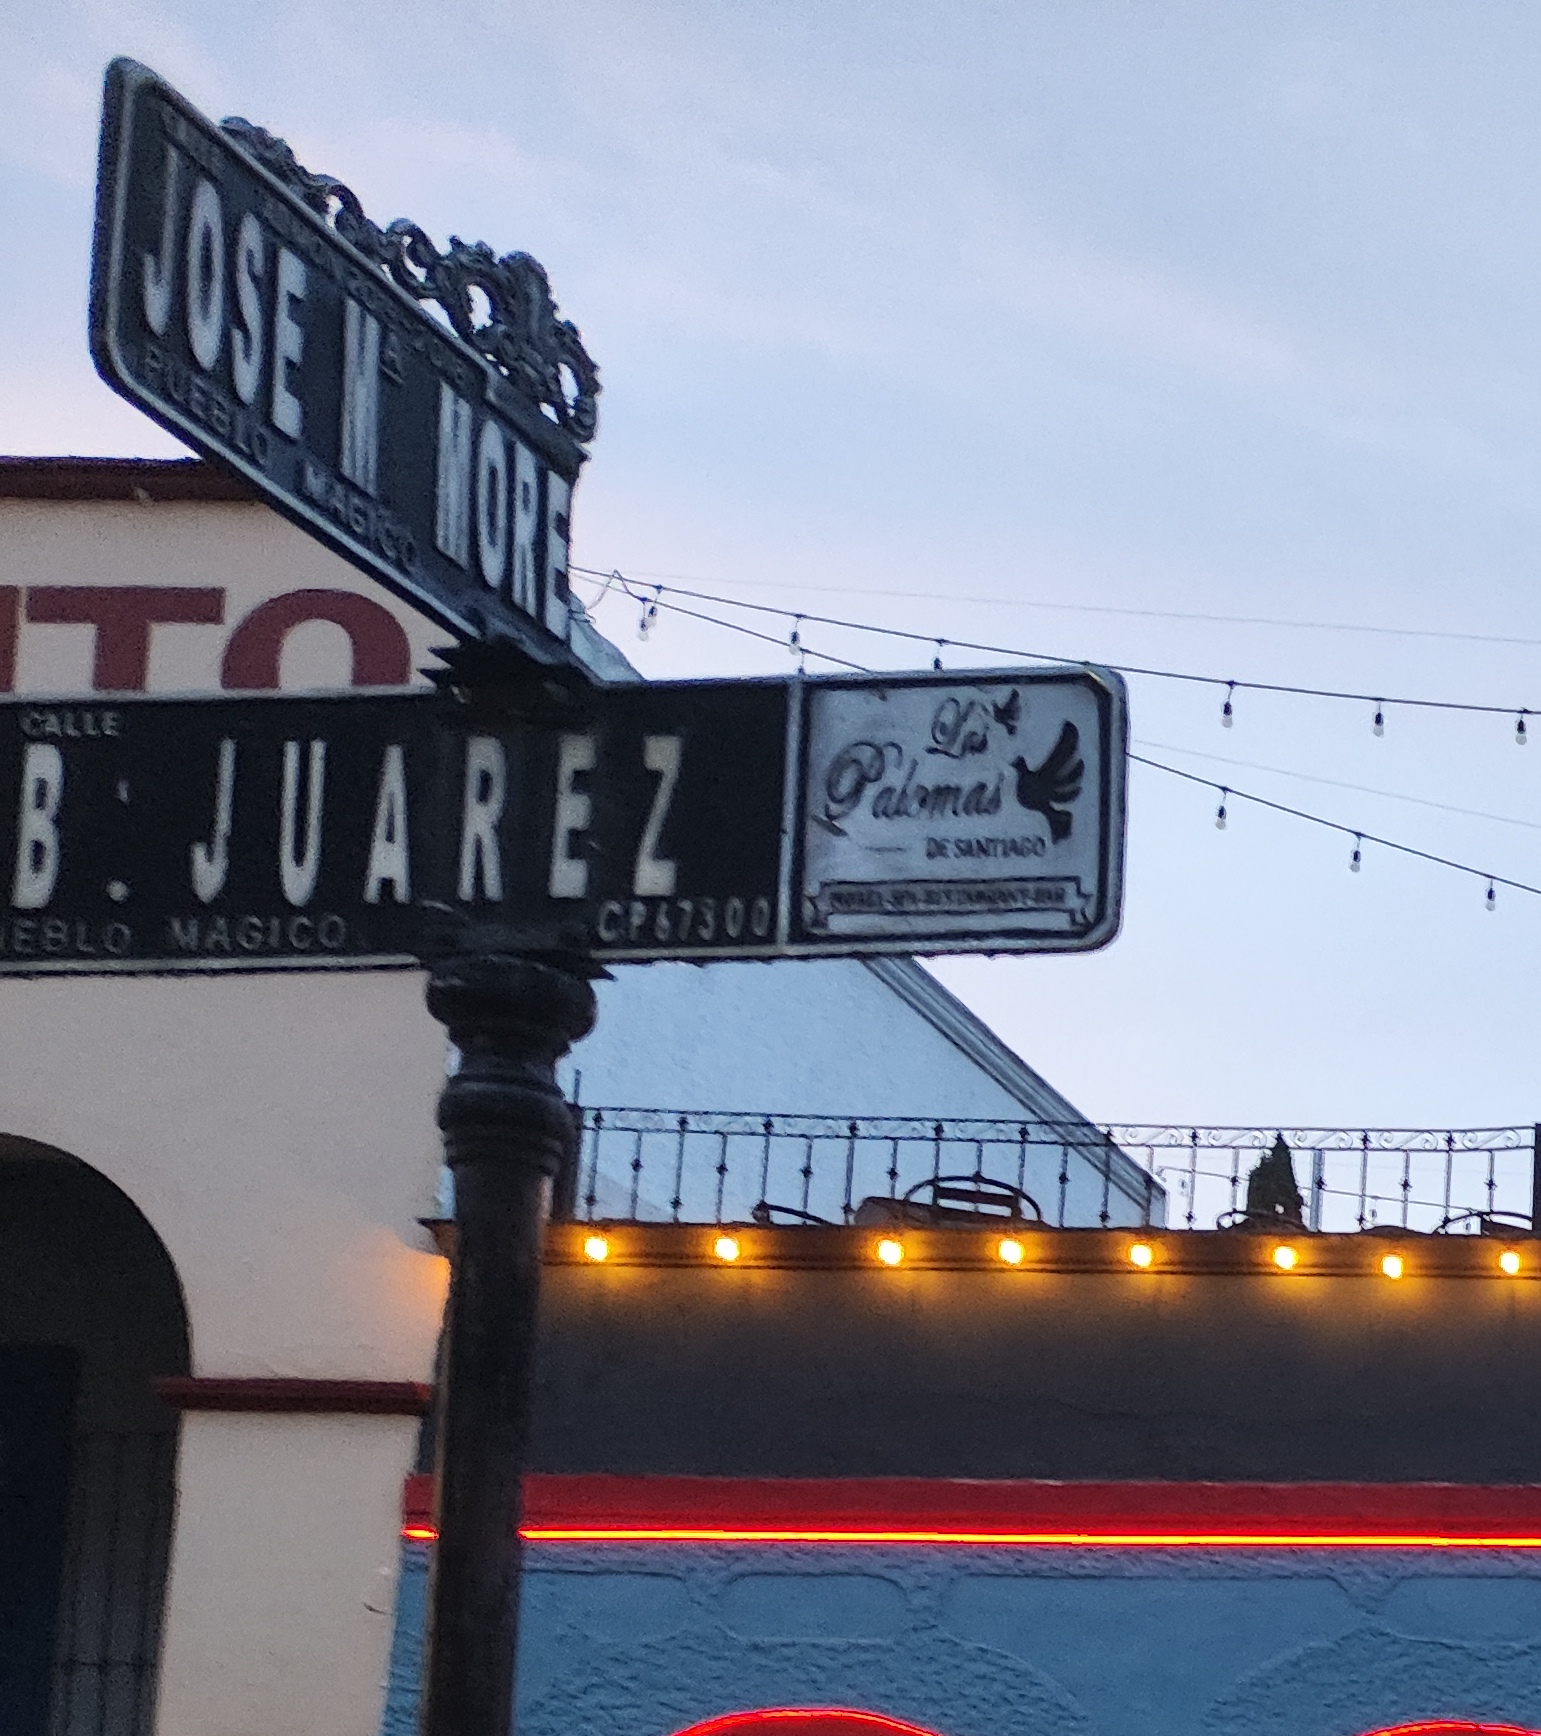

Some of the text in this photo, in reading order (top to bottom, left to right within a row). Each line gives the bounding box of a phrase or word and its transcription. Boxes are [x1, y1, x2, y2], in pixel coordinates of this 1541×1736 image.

[142, 143, 306, 440] JOSE
[20, 707, 122, 738] CALLE
[190, 734, 683, 907] JUAREZ
[953, 835, 1047, 858] SANTIAGO
[0, 912, 349, 953] EBLO MAGICO
